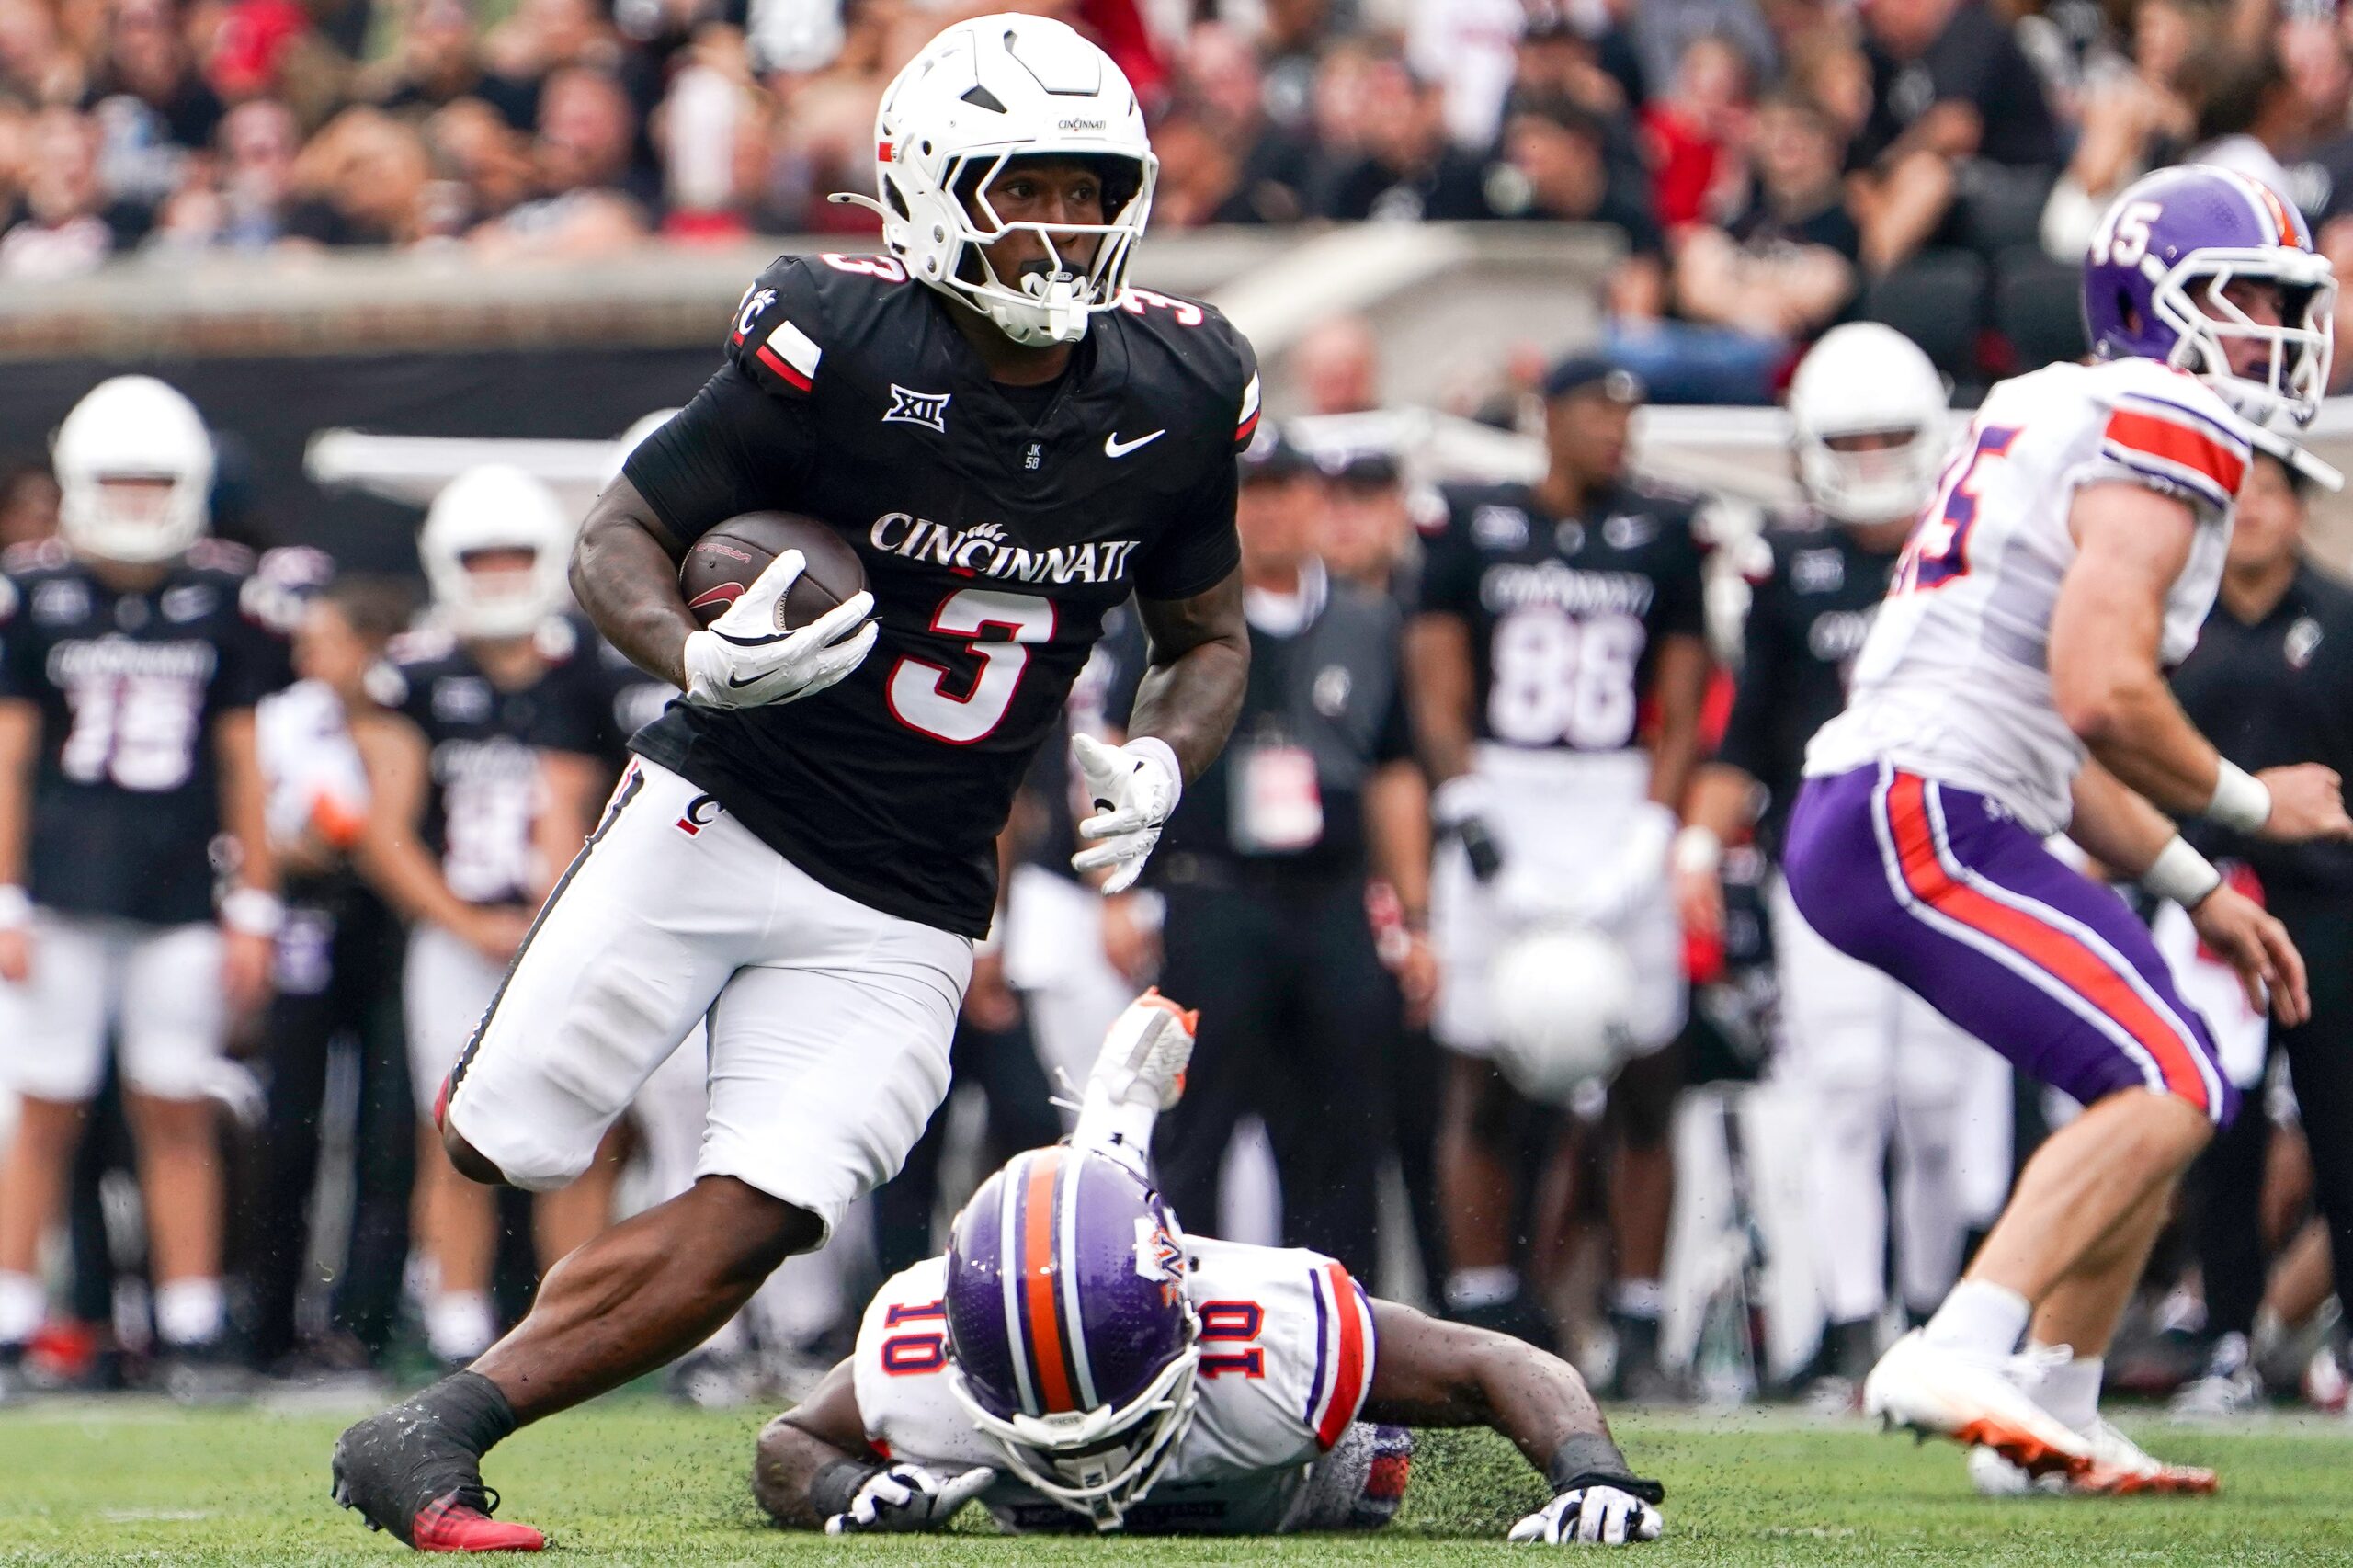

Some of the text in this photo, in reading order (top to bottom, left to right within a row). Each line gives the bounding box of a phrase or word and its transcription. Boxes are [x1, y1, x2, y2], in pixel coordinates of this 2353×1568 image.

[1025, 456, 1040, 470] 58
[1027, 444, 1041, 457] JK
[870, 512, 1141, 584] CINCINNATI
[886, 588, 1058, 745] 3
[881, 1299, 949, 1377] 10
[1198, 1301, 1266, 1379] 10
